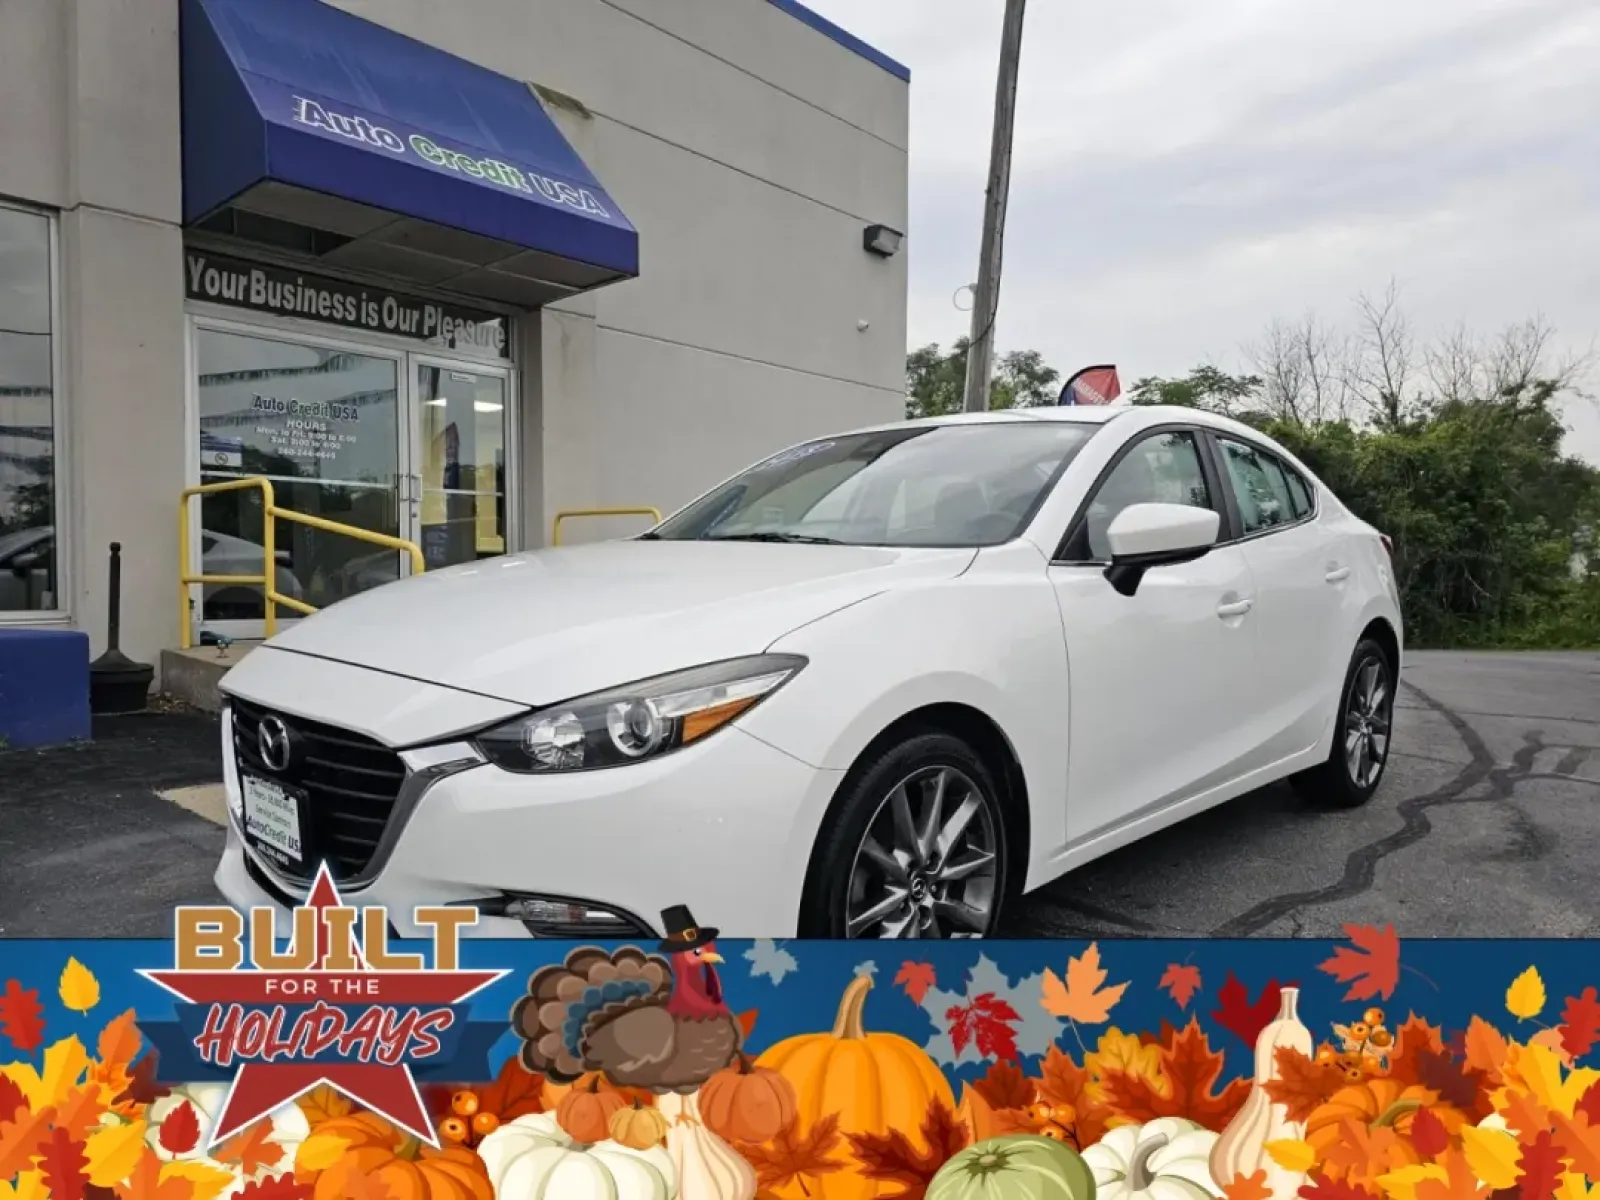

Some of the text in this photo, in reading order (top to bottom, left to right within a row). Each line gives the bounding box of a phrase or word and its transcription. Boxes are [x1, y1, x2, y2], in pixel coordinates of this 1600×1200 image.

[292, 95, 610, 218] Auto Credit USA
[187, 255, 505, 349] Your Business is Our Pleasure
[252, 393, 359, 421] Auto Credit USA
[286, 420, 327, 431] HOURS
